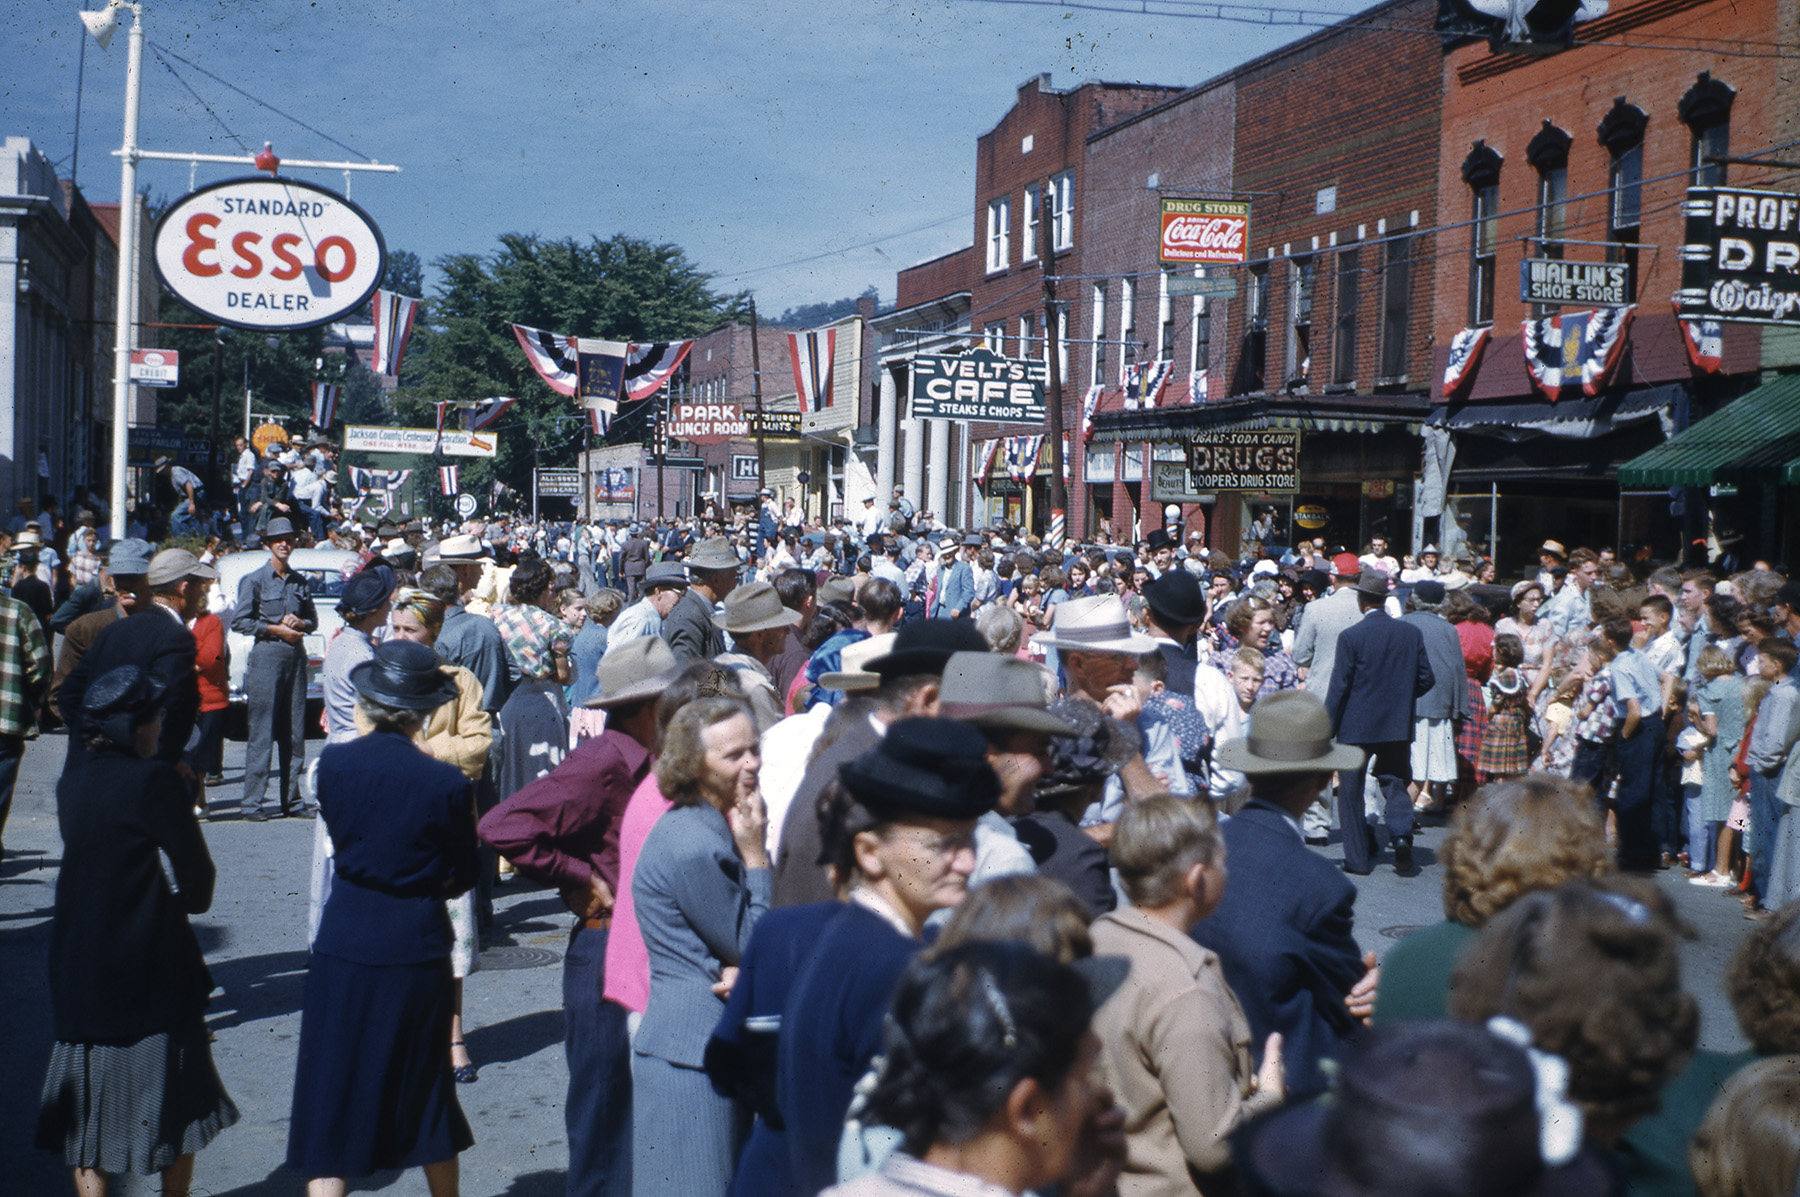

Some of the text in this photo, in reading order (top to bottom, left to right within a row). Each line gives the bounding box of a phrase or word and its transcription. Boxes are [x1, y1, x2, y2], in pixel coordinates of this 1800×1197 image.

[1166, 201, 1246, 214] DRUG STORE
[1715, 194, 1800, 231] PROF
[1163, 216, 1246, 249] Coca-Cola
[1208, 250, 1243, 261] Refreshing
[1718, 238, 1800, 273] DR
[1531, 262, 1624, 287] WALLIN'S
[227, 291, 309, 311] DEALER
[1532, 282, 1623, 302] SHOE STORE
[940, 359, 1024, 380] VELT'S
[926, 378, 1035, 404] CAFE
[680, 405, 736, 421] PARK
[939, 402, 1023, 417] STEAKS & CHOPS
[349, 428, 378, 440] Jackson
[380, 430, 401, 443] County
[402, 431, 434, 443] Centennial
[668, 422, 749, 436] LUNCH ROOM
[1262, 433, 1296, 444] CANDY
[1191, 446, 1295, 472] DRUGS
[1191, 472, 1296, 488] HOOPER'S DRUG STORE
[1294, 512, 1331, 520] STANBACK
